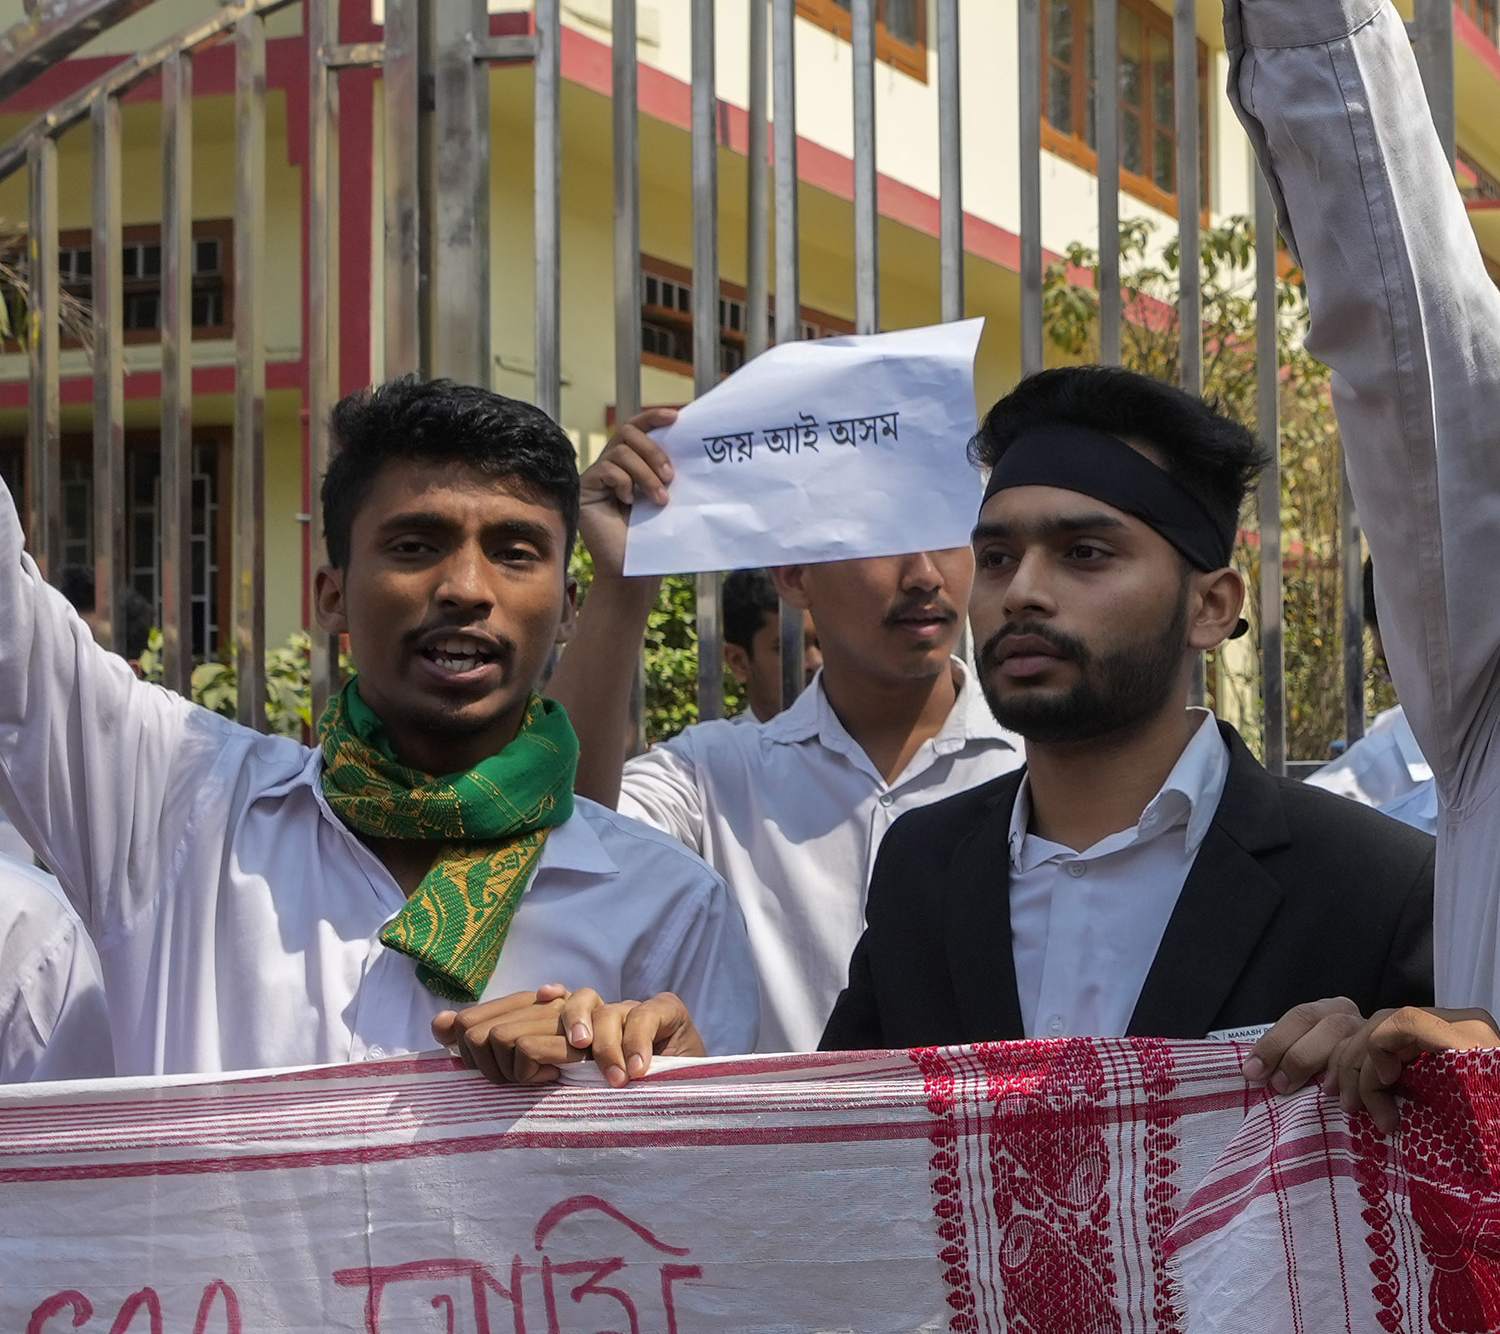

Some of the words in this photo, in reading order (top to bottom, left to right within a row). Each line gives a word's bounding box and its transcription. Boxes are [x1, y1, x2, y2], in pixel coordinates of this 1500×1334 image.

[701, 431, 755, 465] জয়
[763, 411, 821, 454] আই
[827, 411, 900, 447] অসম
